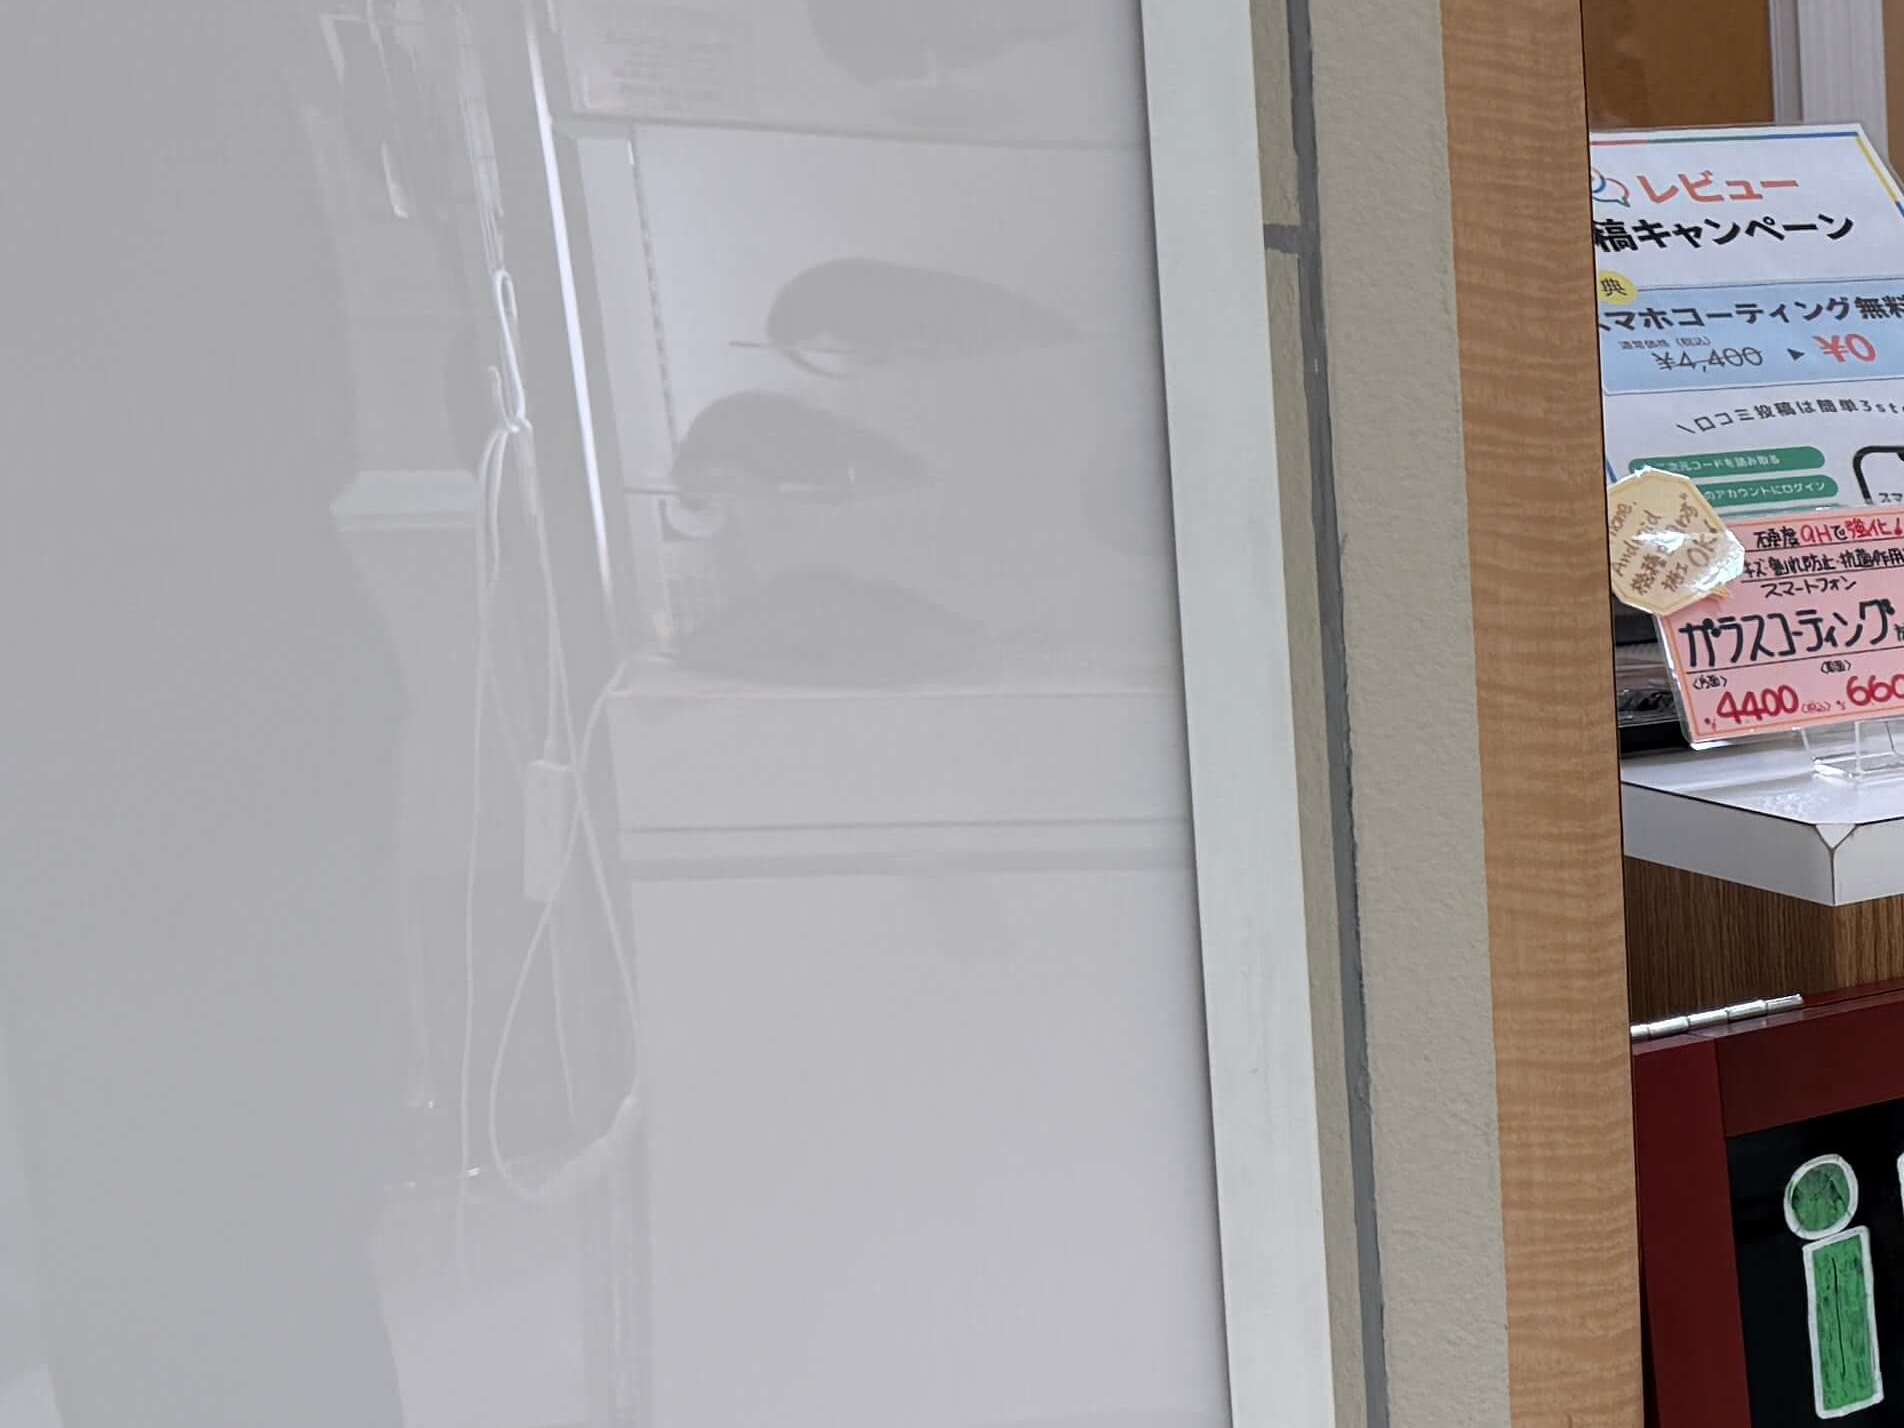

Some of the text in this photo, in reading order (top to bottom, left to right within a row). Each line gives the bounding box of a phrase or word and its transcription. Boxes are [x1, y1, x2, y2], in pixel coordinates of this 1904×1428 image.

[1636, 170, 1799, 204] レビュー
[1811, 333, 1877, 363] ¥0
[1760, 576, 1857, 598] スマートフォン
